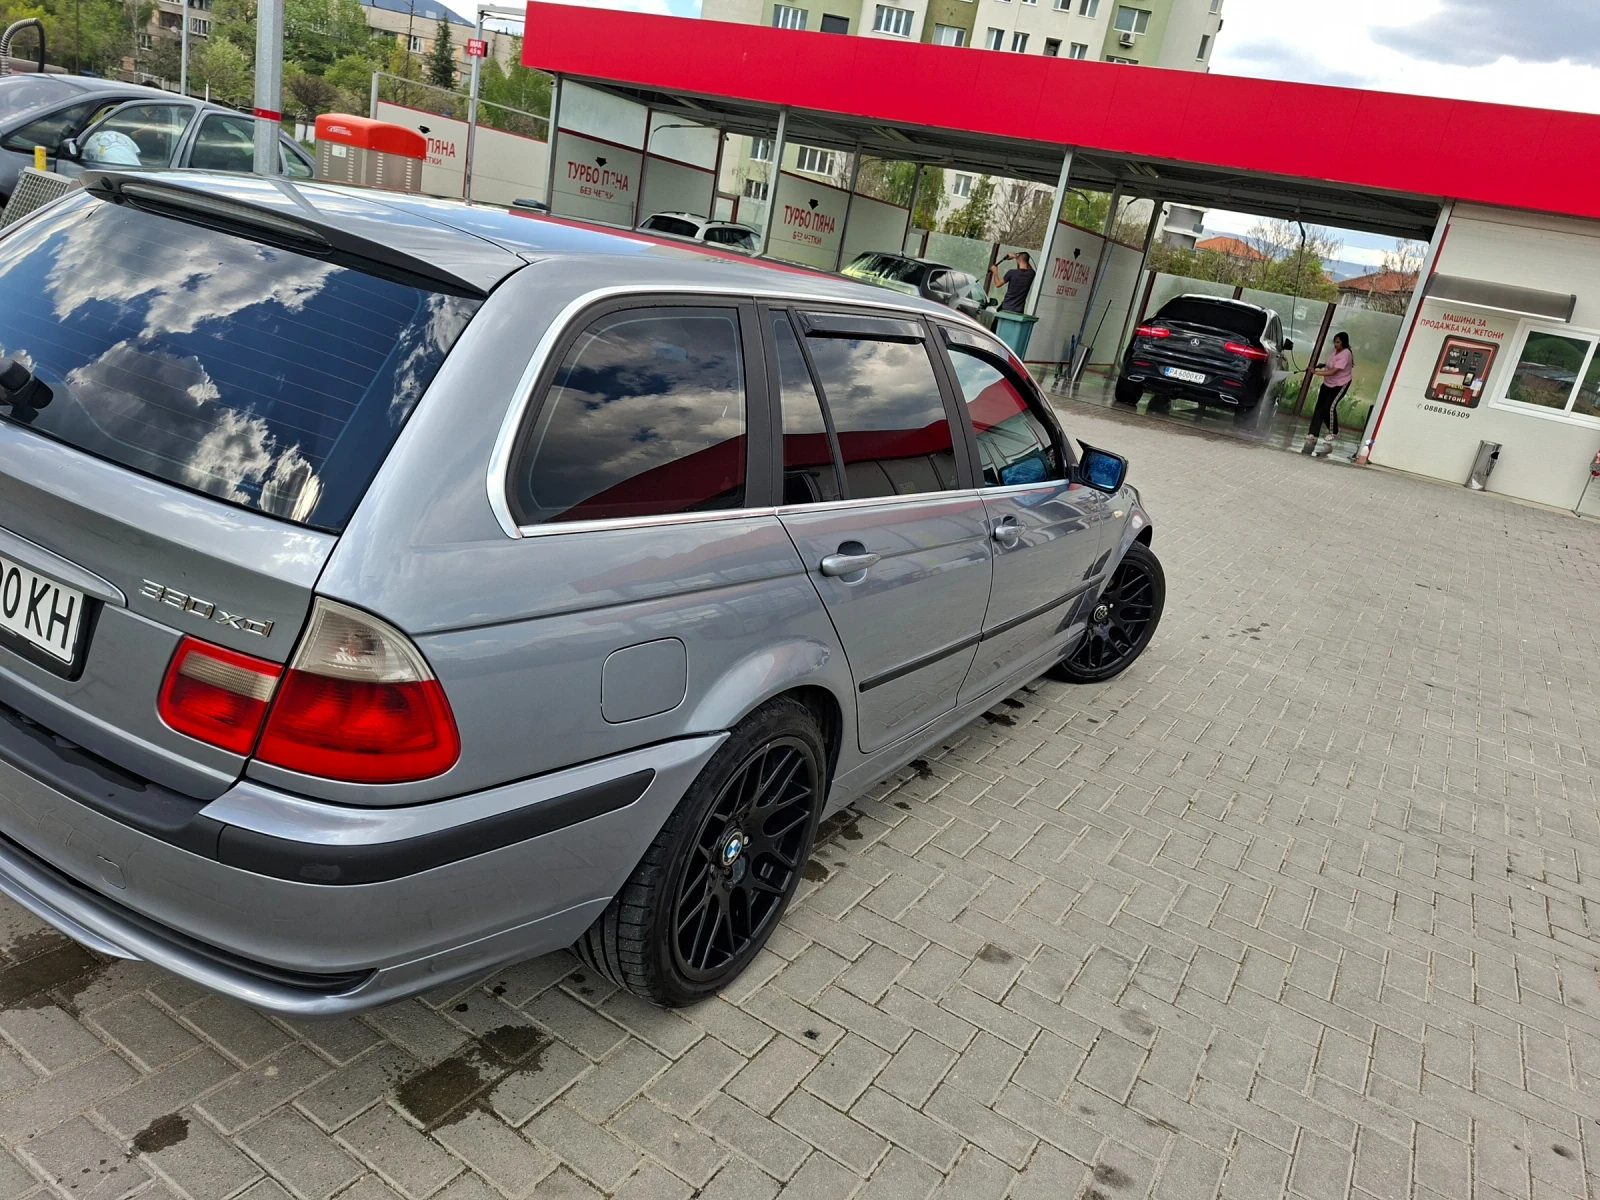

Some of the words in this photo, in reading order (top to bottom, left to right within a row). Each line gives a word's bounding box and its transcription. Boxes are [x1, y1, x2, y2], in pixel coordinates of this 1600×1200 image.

[427, 138, 456, 158] ПЯНА
[422, 156, 443, 166] ЕТКИ
[568, 161, 600, 184] ТУРБО
[580, 186, 592, 196] БЕЗ
[784, 205, 812, 229] ТУРБО
[812, 212, 836, 235] ПЯНА
[1052, 257, 1074, 281] ТУРБО
[1420, 318, 1460, 333] ПРОДАЖБА
[1461, 326, 1472, 335] НА
[1473, 328, 1505, 340] ЖЕТОНИ
[1442, 313, 1476, 326] МАШИНА
[1477, 317, 1487, 328] ЗА
[1438, 393, 1467, 403] ЖЕТОНИ
[1424, 404, 1471, 420] 0888366309
